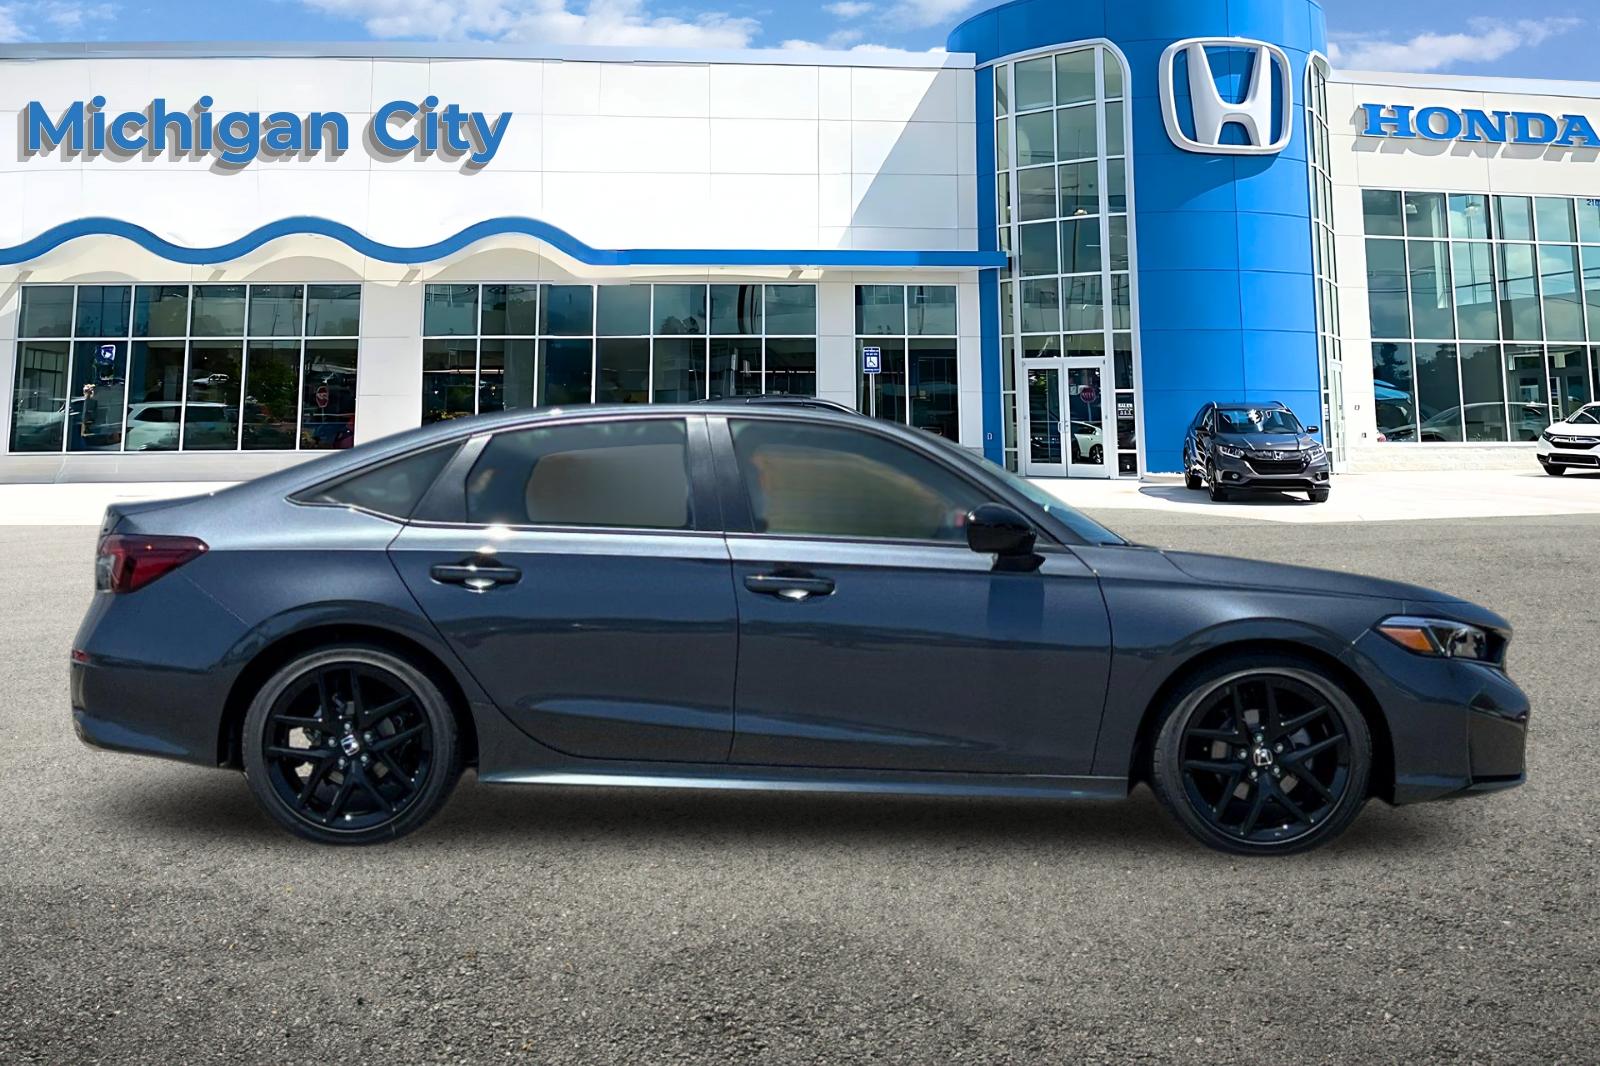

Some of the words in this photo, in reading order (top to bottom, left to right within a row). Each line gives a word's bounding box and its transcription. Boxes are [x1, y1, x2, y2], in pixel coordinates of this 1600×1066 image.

[28, 95, 349, 163] Michigan
[374, 95, 513, 164] City
[1362, 103, 1600, 148] HONDA
